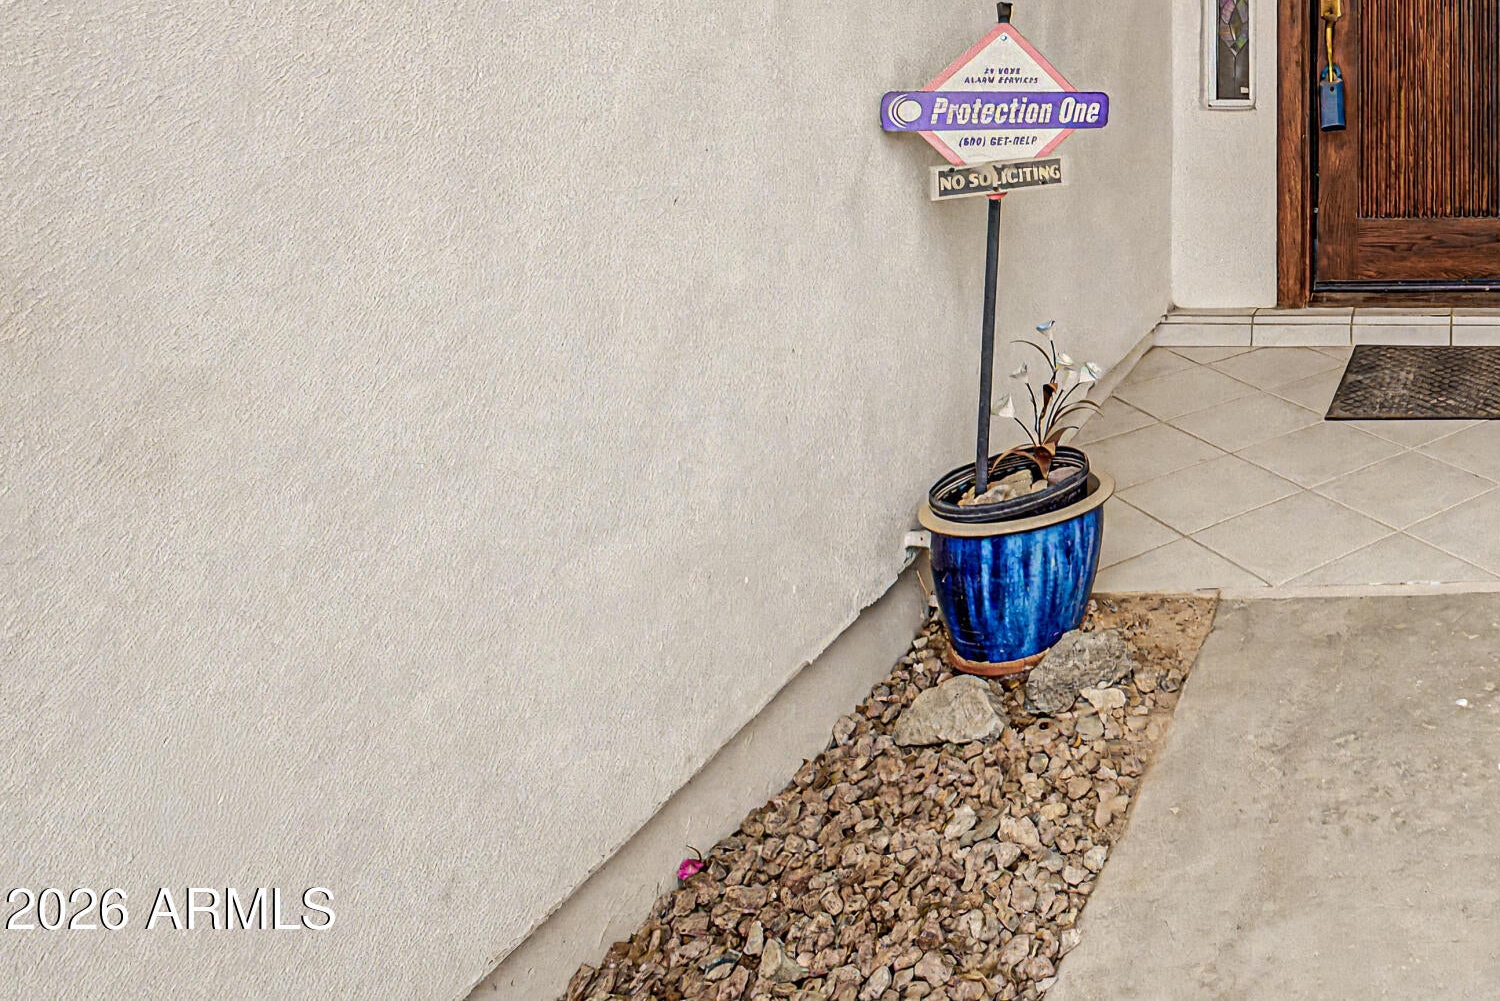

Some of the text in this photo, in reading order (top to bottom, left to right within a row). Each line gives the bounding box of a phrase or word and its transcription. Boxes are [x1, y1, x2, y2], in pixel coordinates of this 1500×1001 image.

[930, 96, 1100, 125] Protection One
[940, 164, 1060, 191] NO SOLICITING
